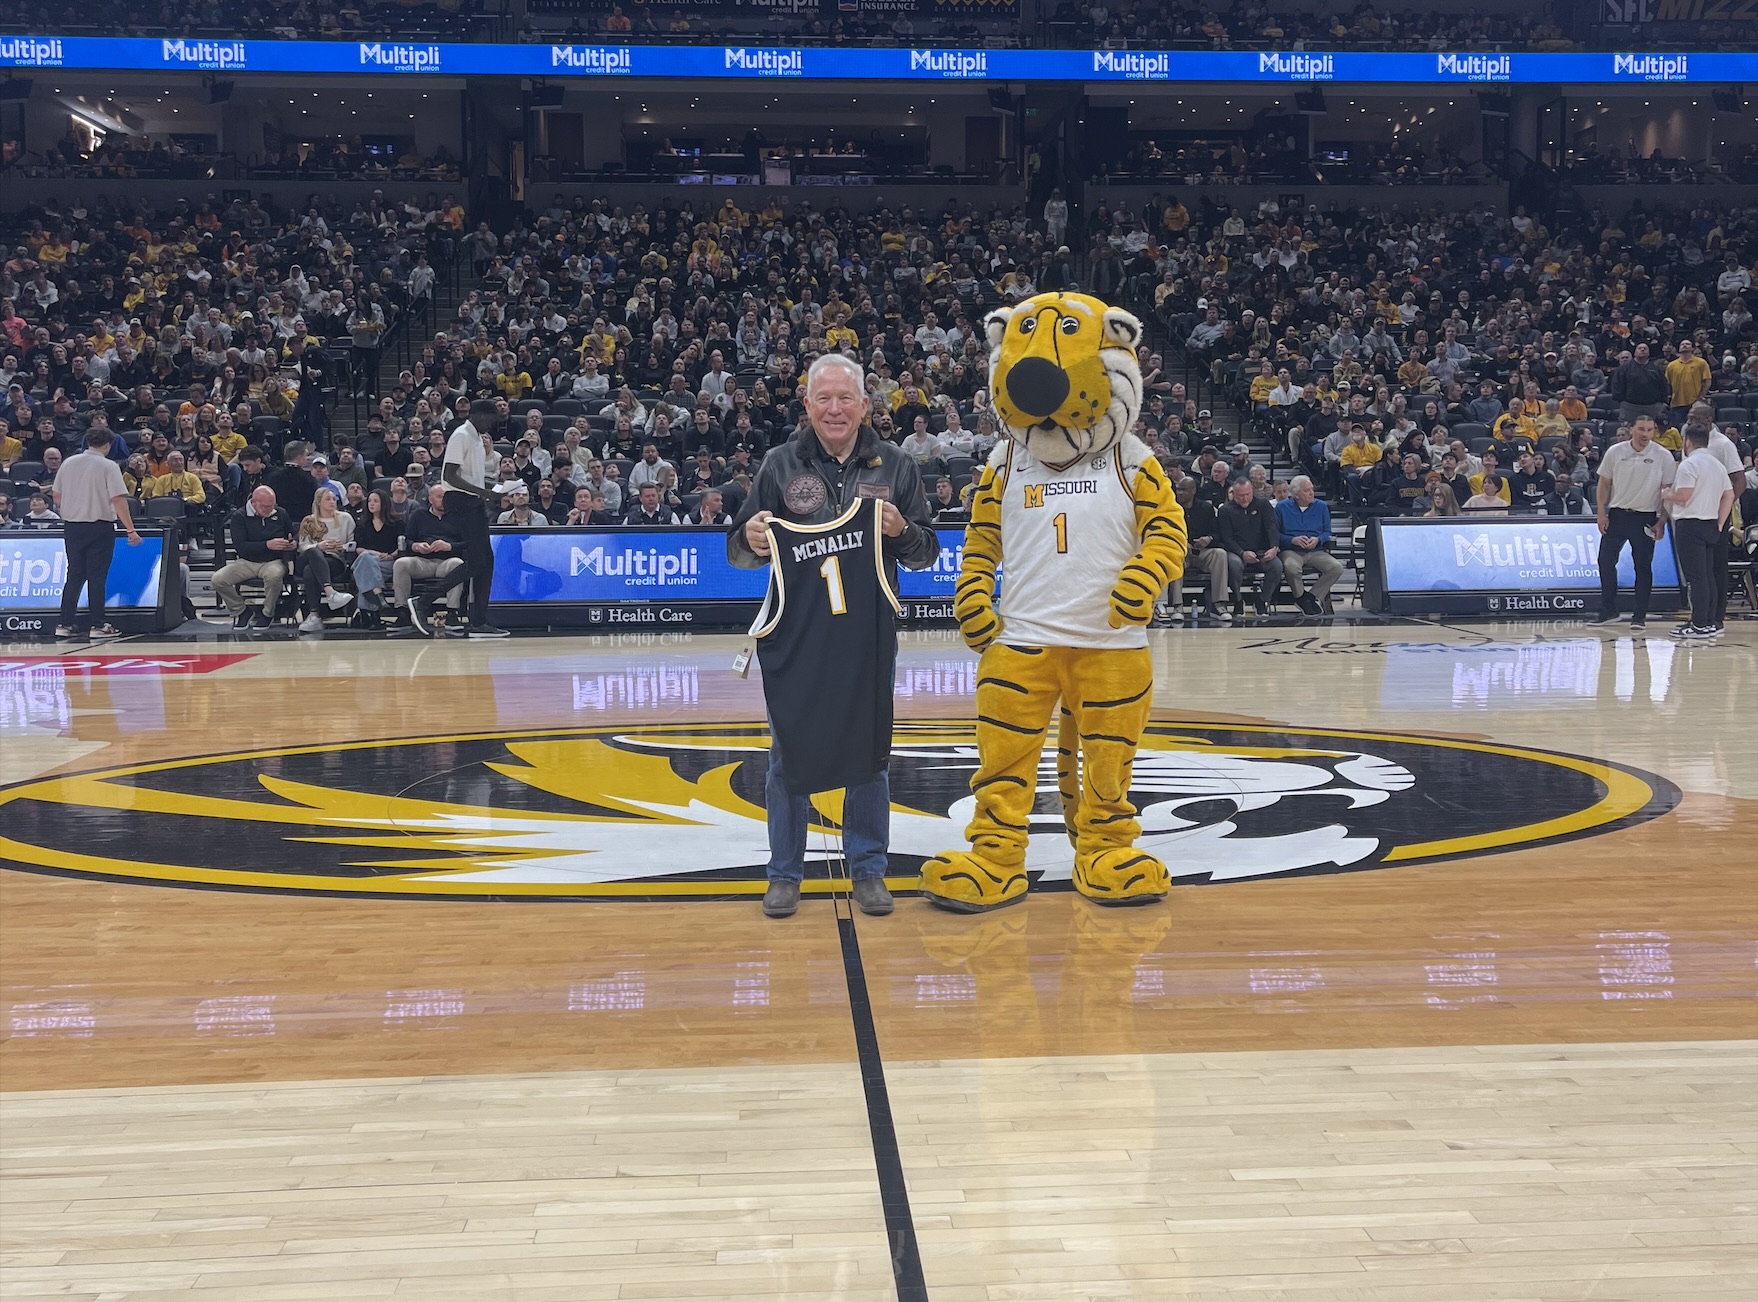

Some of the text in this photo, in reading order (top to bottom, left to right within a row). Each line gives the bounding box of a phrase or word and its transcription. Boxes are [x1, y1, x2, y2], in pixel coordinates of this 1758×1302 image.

[860, 2, 915, 11] INSURANCE
[163, 39, 245, 69] Multipli
[360, 43, 440, 71] Multipli
[551, 46, 631, 74] Multipli
[725, 48, 802, 76] Multipli
[911, 50, 987, 77] Multipli
[1093, 52, 1169, 78] Multipli
[1259, 52, 1334, 79] Multipli
[1438, 54, 1511, 80] Multipli
[1613, 54, 1688, 80] Multipli
[1024, 480, 1098, 509] MISSOURI
[792, 530, 864, 563] MCNALLY
[1053, 512, 1068, 554] 1
[570, 546, 698, 586] Multipli
[1453, 533, 1599, 578] Multipli
[625, 576, 698, 586] credit union
[820, 555, 848, 616] 1
[1519, 567, 1600, 578] credit union
[32, 585, 63, 597] unio
[1505, 596, 1551, 610] Health
[1553, 595, 1585, 609] Care
[6, 616, 42, 630] Care
[608, 608, 656, 622] Health
[665, 608, 693, 622] Care
